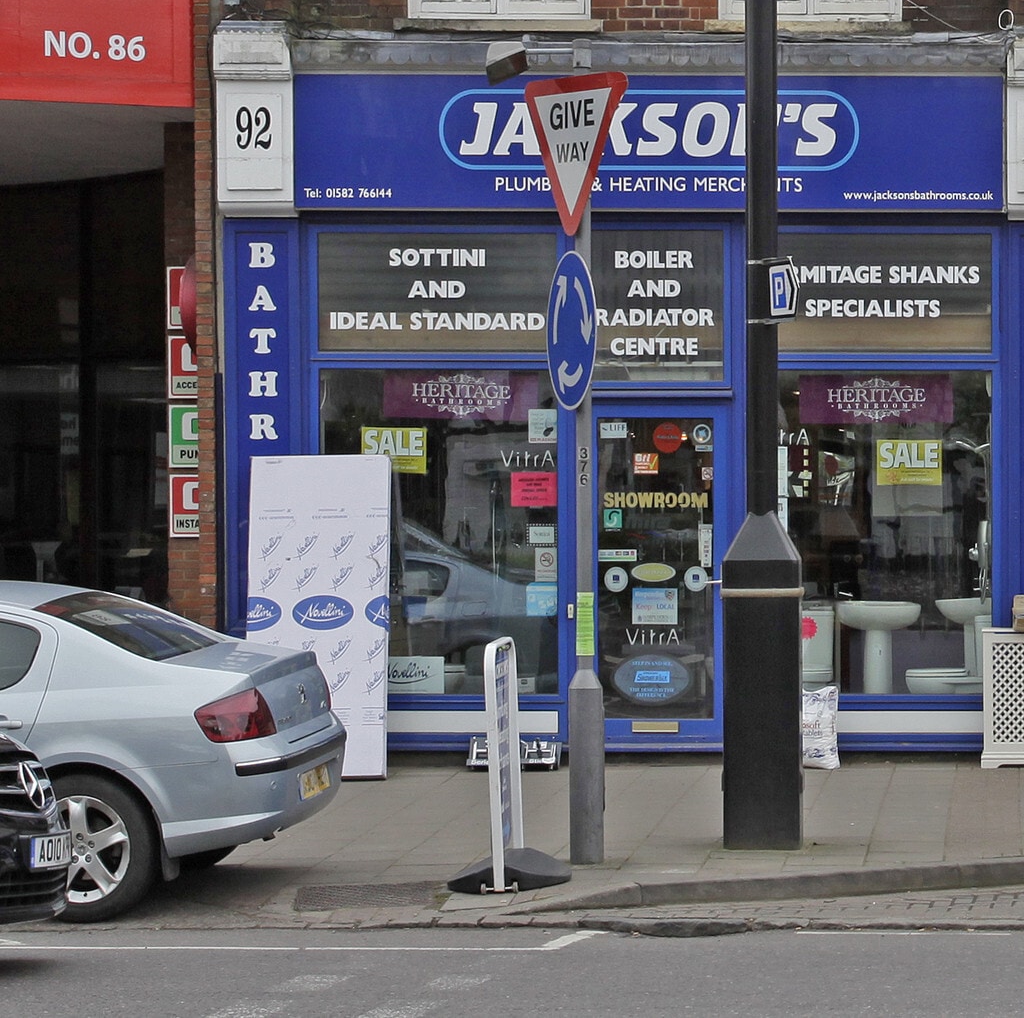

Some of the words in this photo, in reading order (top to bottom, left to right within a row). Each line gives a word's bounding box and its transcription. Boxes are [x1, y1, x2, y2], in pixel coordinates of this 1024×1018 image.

[43, 29, 101, 60] NO.
[108, 33, 147, 62] 86
[549, 98, 595, 131] GIVE
[235, 105, 273, 151] 92
[458, 101, 839, 157] JAKSO'S
[556, 142, 590, 164] WAY
[304, 188, 323, 200] Tel:
[325, 188, 356, 200] 01582
[357, 188, 393, 200] 766144
[494, 176, 552, 193] PLUMB
[591, 176, 603, 193] &
[609, 176, 687, 193] HEATING
[843, 190, 995, 203] www.jacksonsbathrooms.co.uk
[389, 248, 487, 268] SOTTINI
[614, 250, 694, 270] BOILER
[888, 265, 981, 284] SHANKS
[408, 280, 467, 299] AND
[627, 279, 682, 298] AND
[774, 276, 784, 307] P
[596, 308, 715, 327] RADIATOR
[804, 299, 942, 318] SPECIALISTS
[329, 311, 403, 331] IDEAL
[409, 311, 546, 331] STANDARD
[610, 337, 699, 356] CENTRE
[411, 382, 512, 400] HERITAGE
[826, 387, 927, 403] HERITAGE
[421, 397, 503, 406] BATHROOMS
[836, 402, 918, 410] BATHROOMS
[363, 429, 424, 457] SALE
[500, 449, 556, 468] VitrA
[879, 441, 940, 469] SALE
[603, 491, 709, 509] SHOWROOM
[625, 628, 680, 646] VitrA
